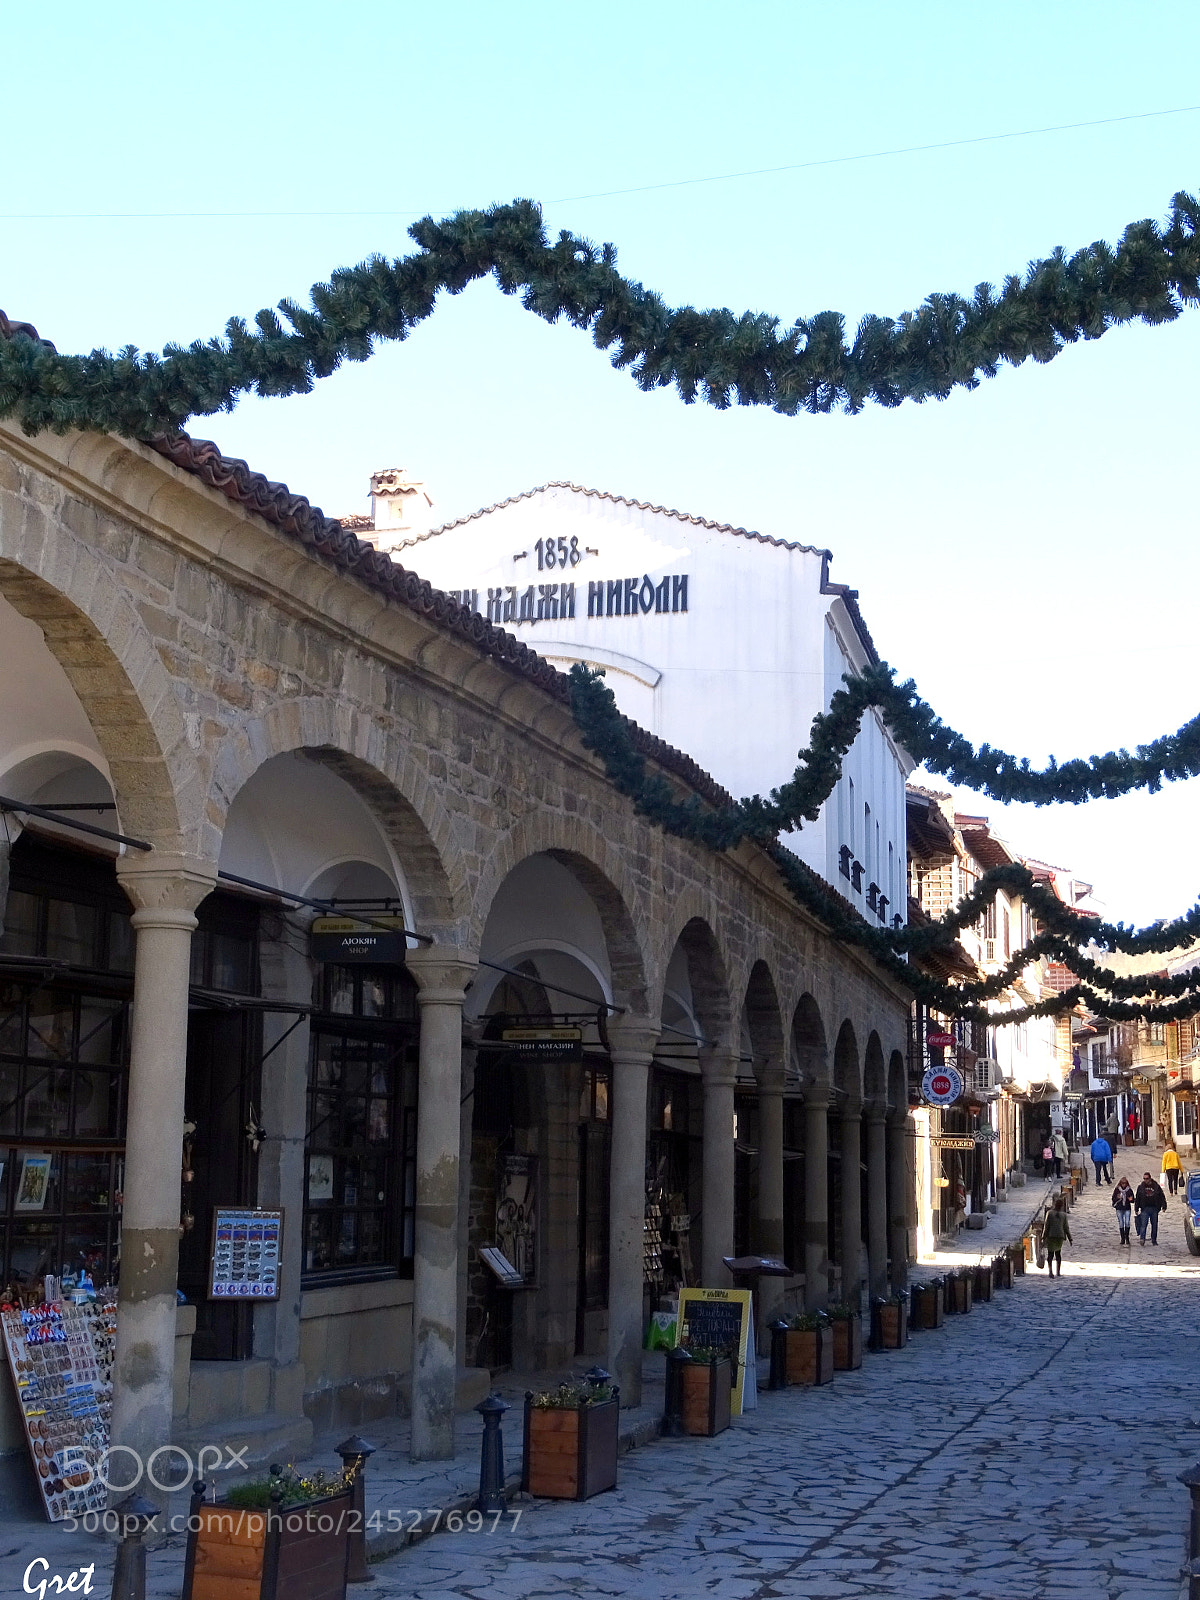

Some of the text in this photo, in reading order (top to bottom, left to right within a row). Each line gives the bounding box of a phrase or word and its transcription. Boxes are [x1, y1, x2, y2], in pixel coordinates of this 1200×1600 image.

[588, 574, 689, 617] НИКОЛИ
[342, 938, 377, 946] ДЮКЯН
[1051, 1104, 1060, 1112] 31
